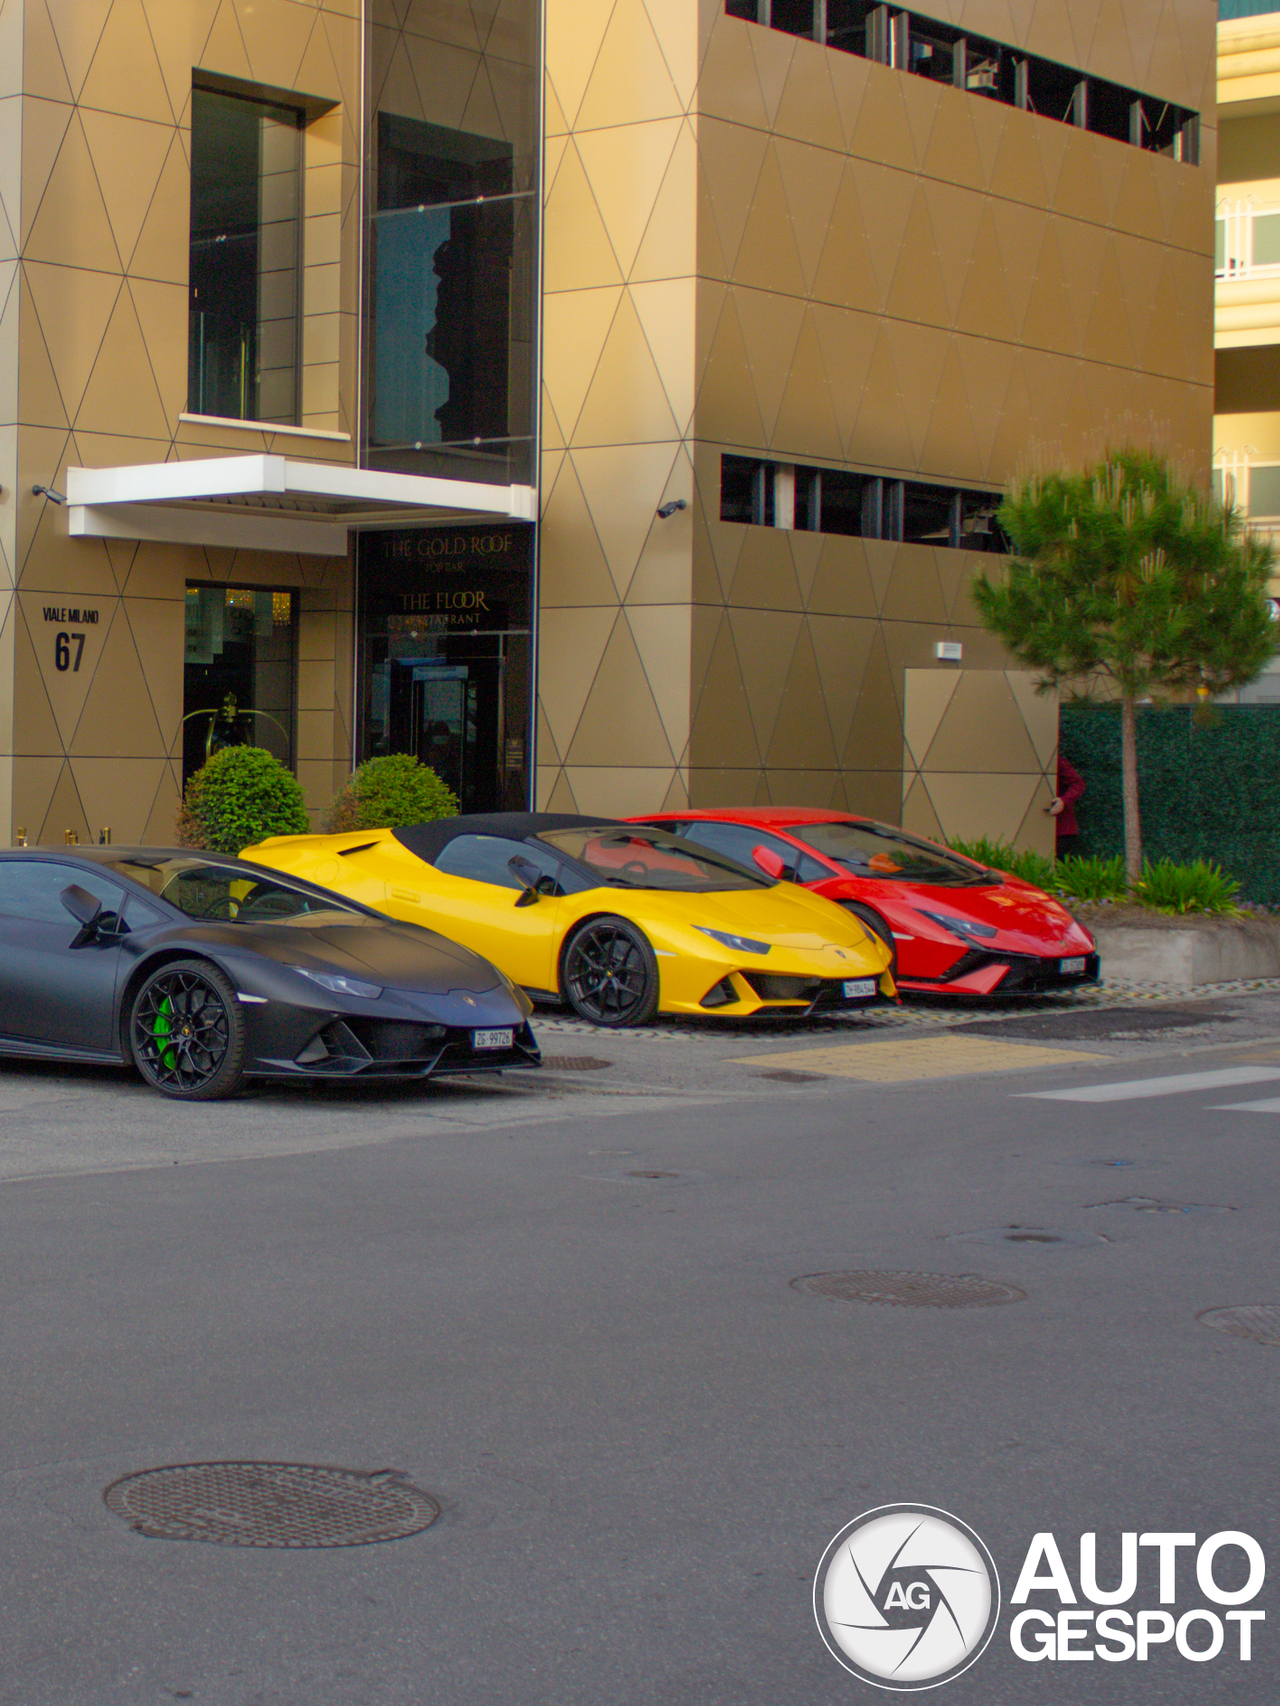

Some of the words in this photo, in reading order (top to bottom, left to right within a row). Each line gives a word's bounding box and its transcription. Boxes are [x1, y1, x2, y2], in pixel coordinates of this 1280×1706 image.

[384, 539, 412, 557] THE
[418, 536, 466, 557] GOLD
[472, 534, 513, 556] ROOF
[401, 593, 430, 610] THE
[436, 591, 490, 611] FLOOR
[43, 606, 67, 622] VIALE
[68, 608, 99, 624] MILANO
[55, 631, 86, 672] 67
